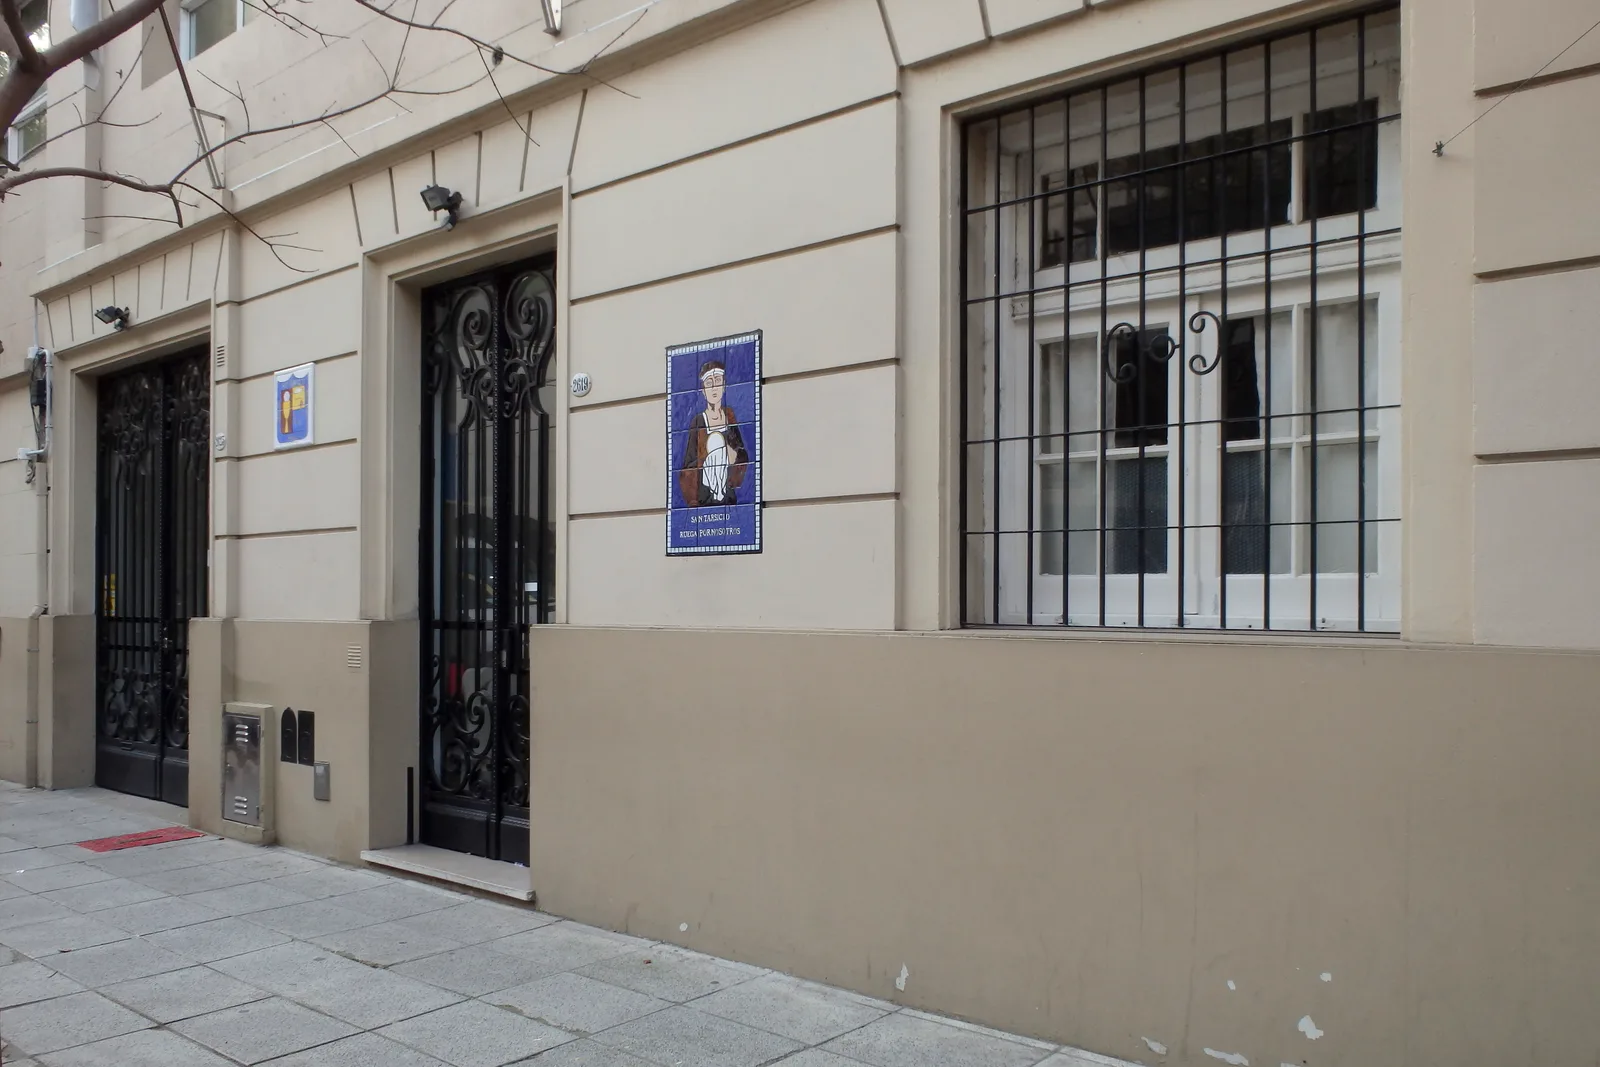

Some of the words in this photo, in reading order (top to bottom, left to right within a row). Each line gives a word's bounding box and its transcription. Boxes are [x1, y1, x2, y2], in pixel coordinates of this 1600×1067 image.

[573, 377, 588, 392] 2619
[691, 515, 702, 523] SAN
[704, 514, 730, 522] TARSICIO
[680, 530, 697, 538] RUEGA
